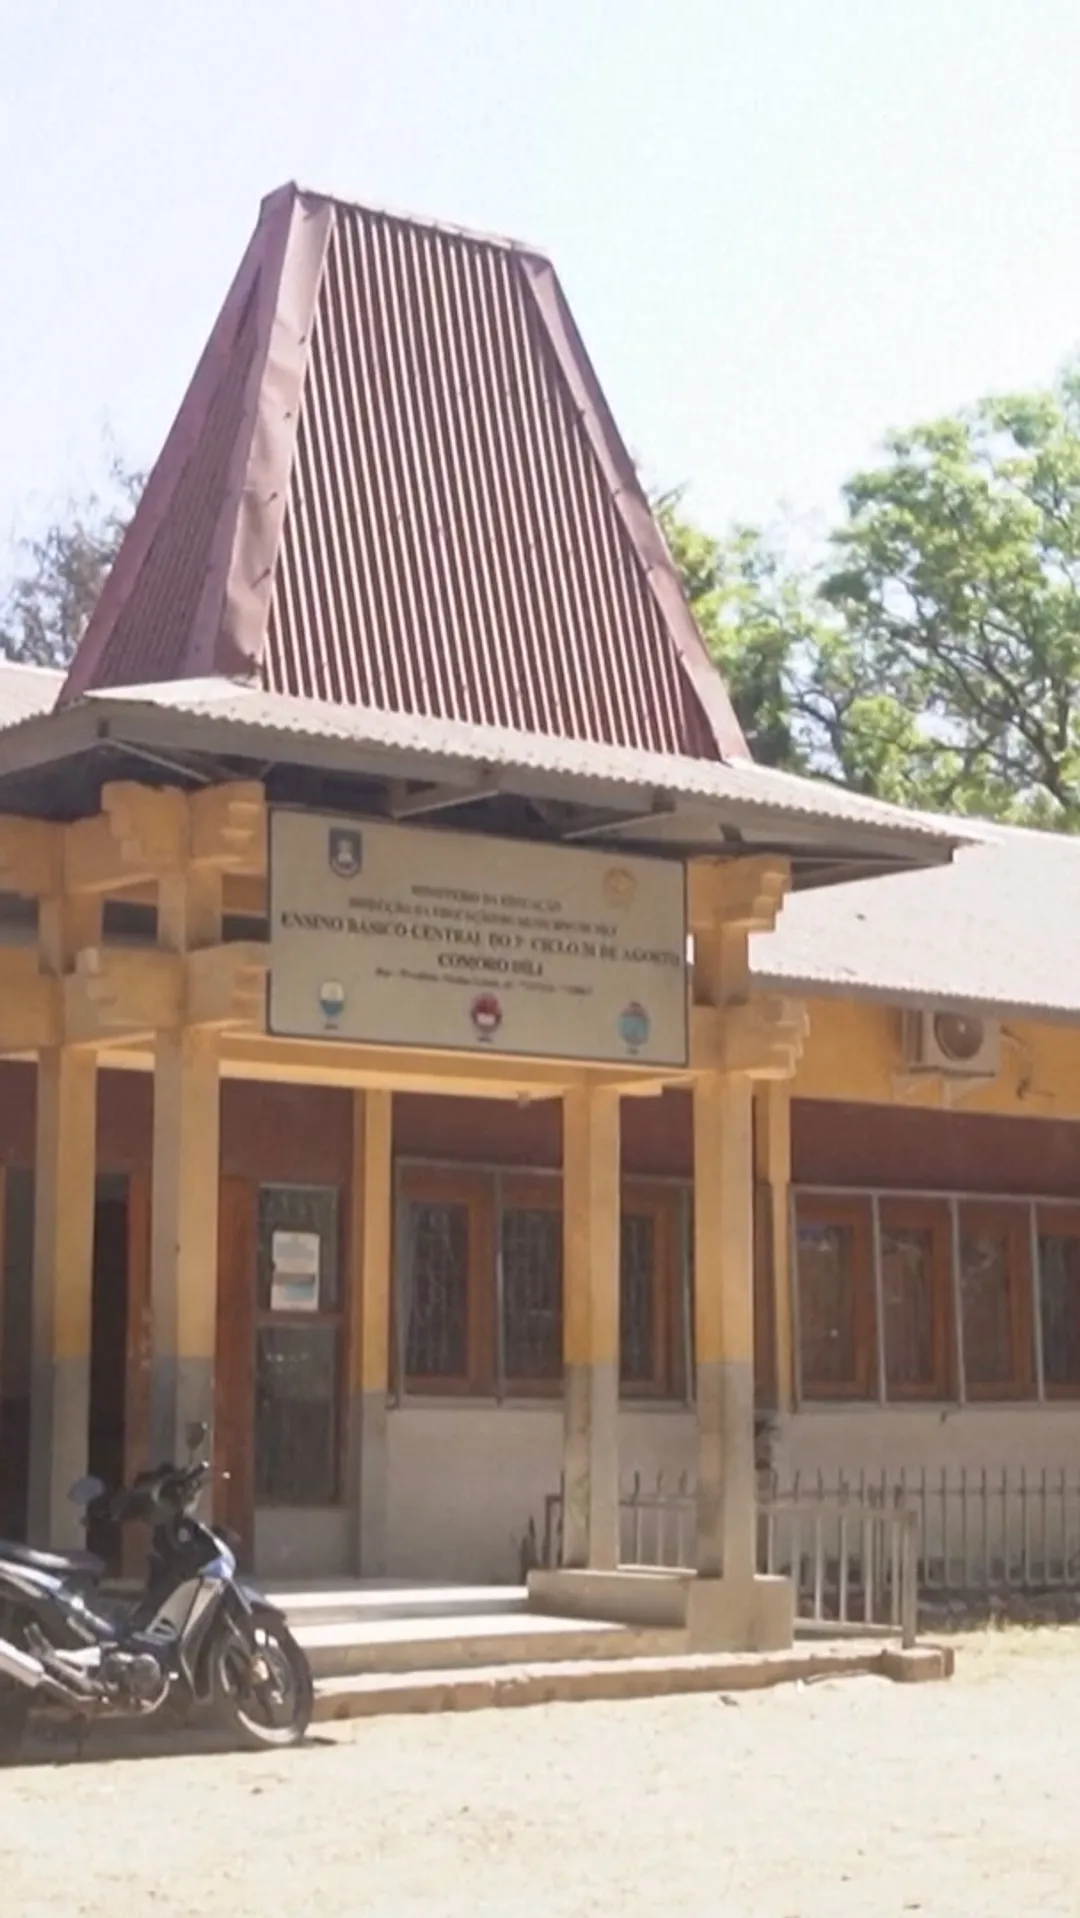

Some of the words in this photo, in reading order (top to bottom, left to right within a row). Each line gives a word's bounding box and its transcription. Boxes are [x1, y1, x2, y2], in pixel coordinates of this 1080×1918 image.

[281, 911, 344, 932] ENSINO
[410, 924, 481, 945] CENTRAL
[488, 932, 511, 949] DO
[529, 938, 579, 955] CICLO
[600, 944, 617, 961] DE
[437, 952, 510, 973] COMORO
